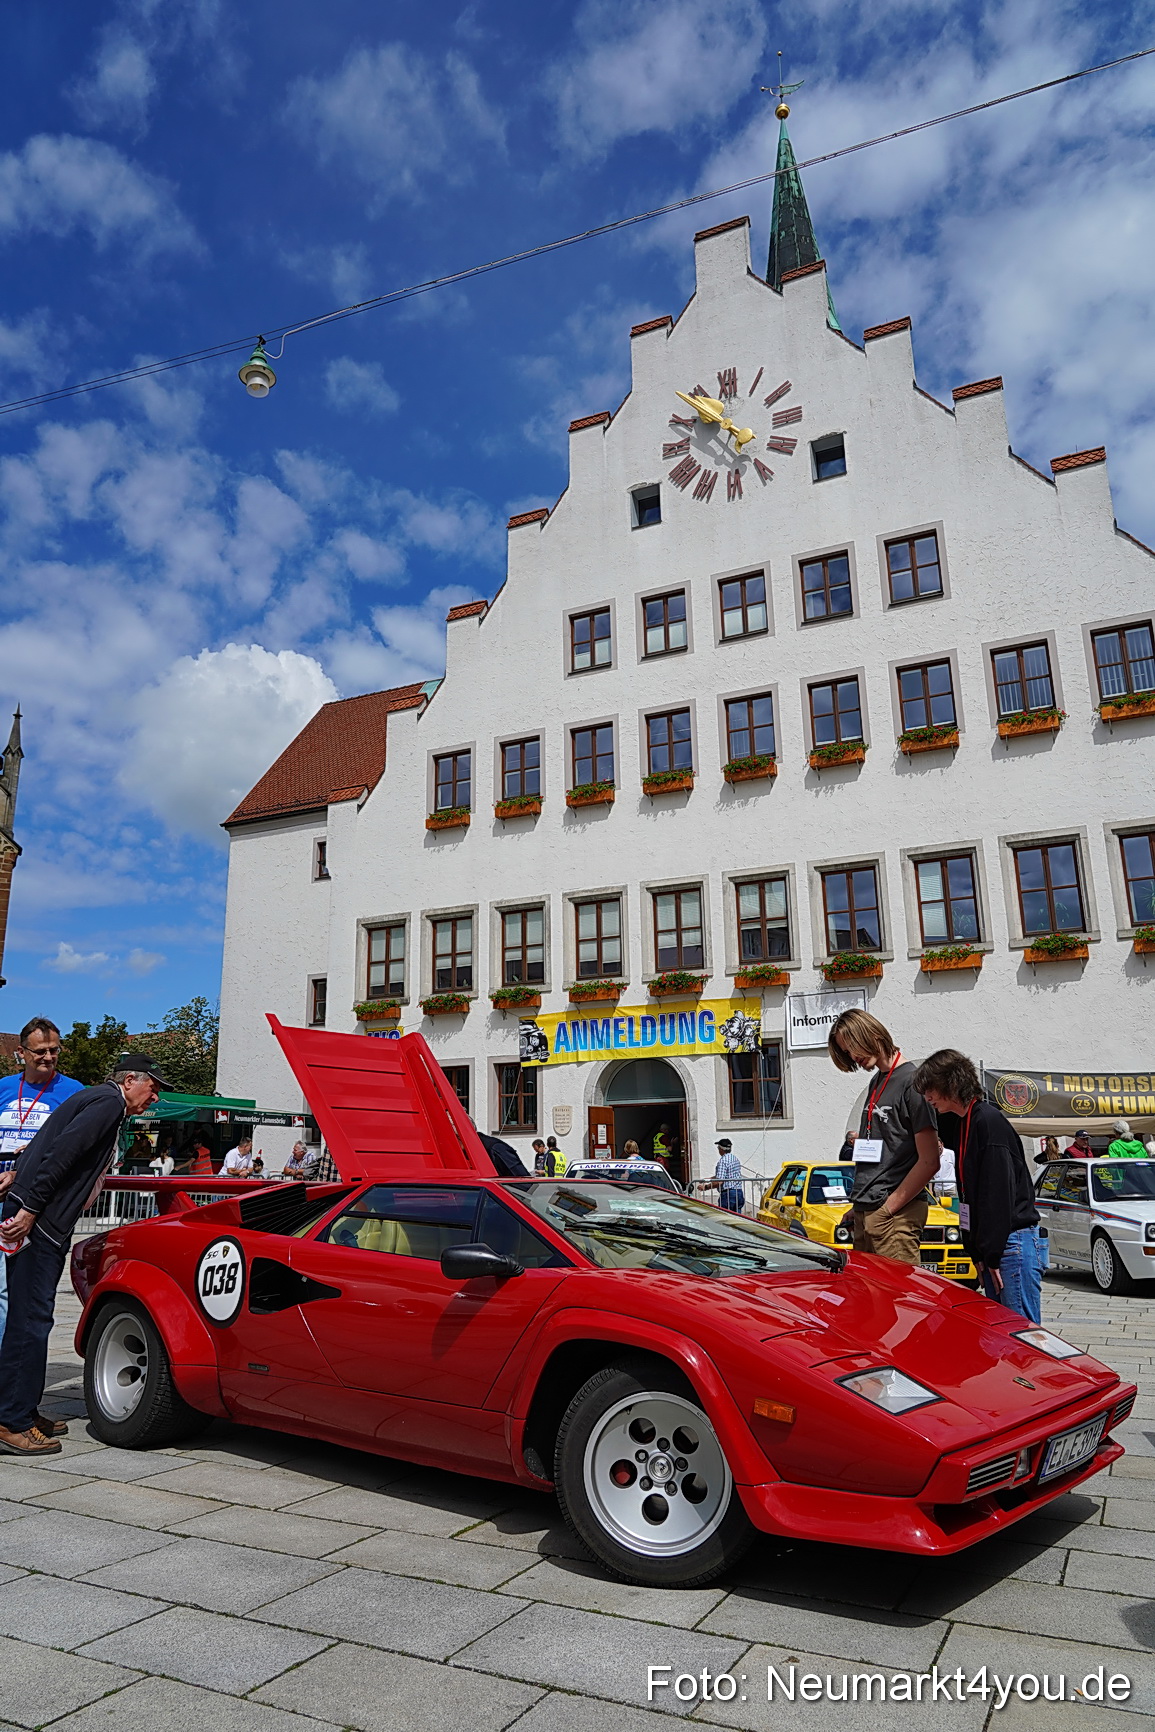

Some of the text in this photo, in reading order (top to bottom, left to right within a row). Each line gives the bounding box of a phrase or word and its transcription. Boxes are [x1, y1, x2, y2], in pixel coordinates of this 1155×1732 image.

[792, 1013, 842, 1027] Informa
[554, 1009, 716, 1054] ANMELDUNG
[1043, 1075, 1059, 1092] 1.
[1076, 1099, 1091, 1107] 75
[202, 1262, 240, 1297] 038
